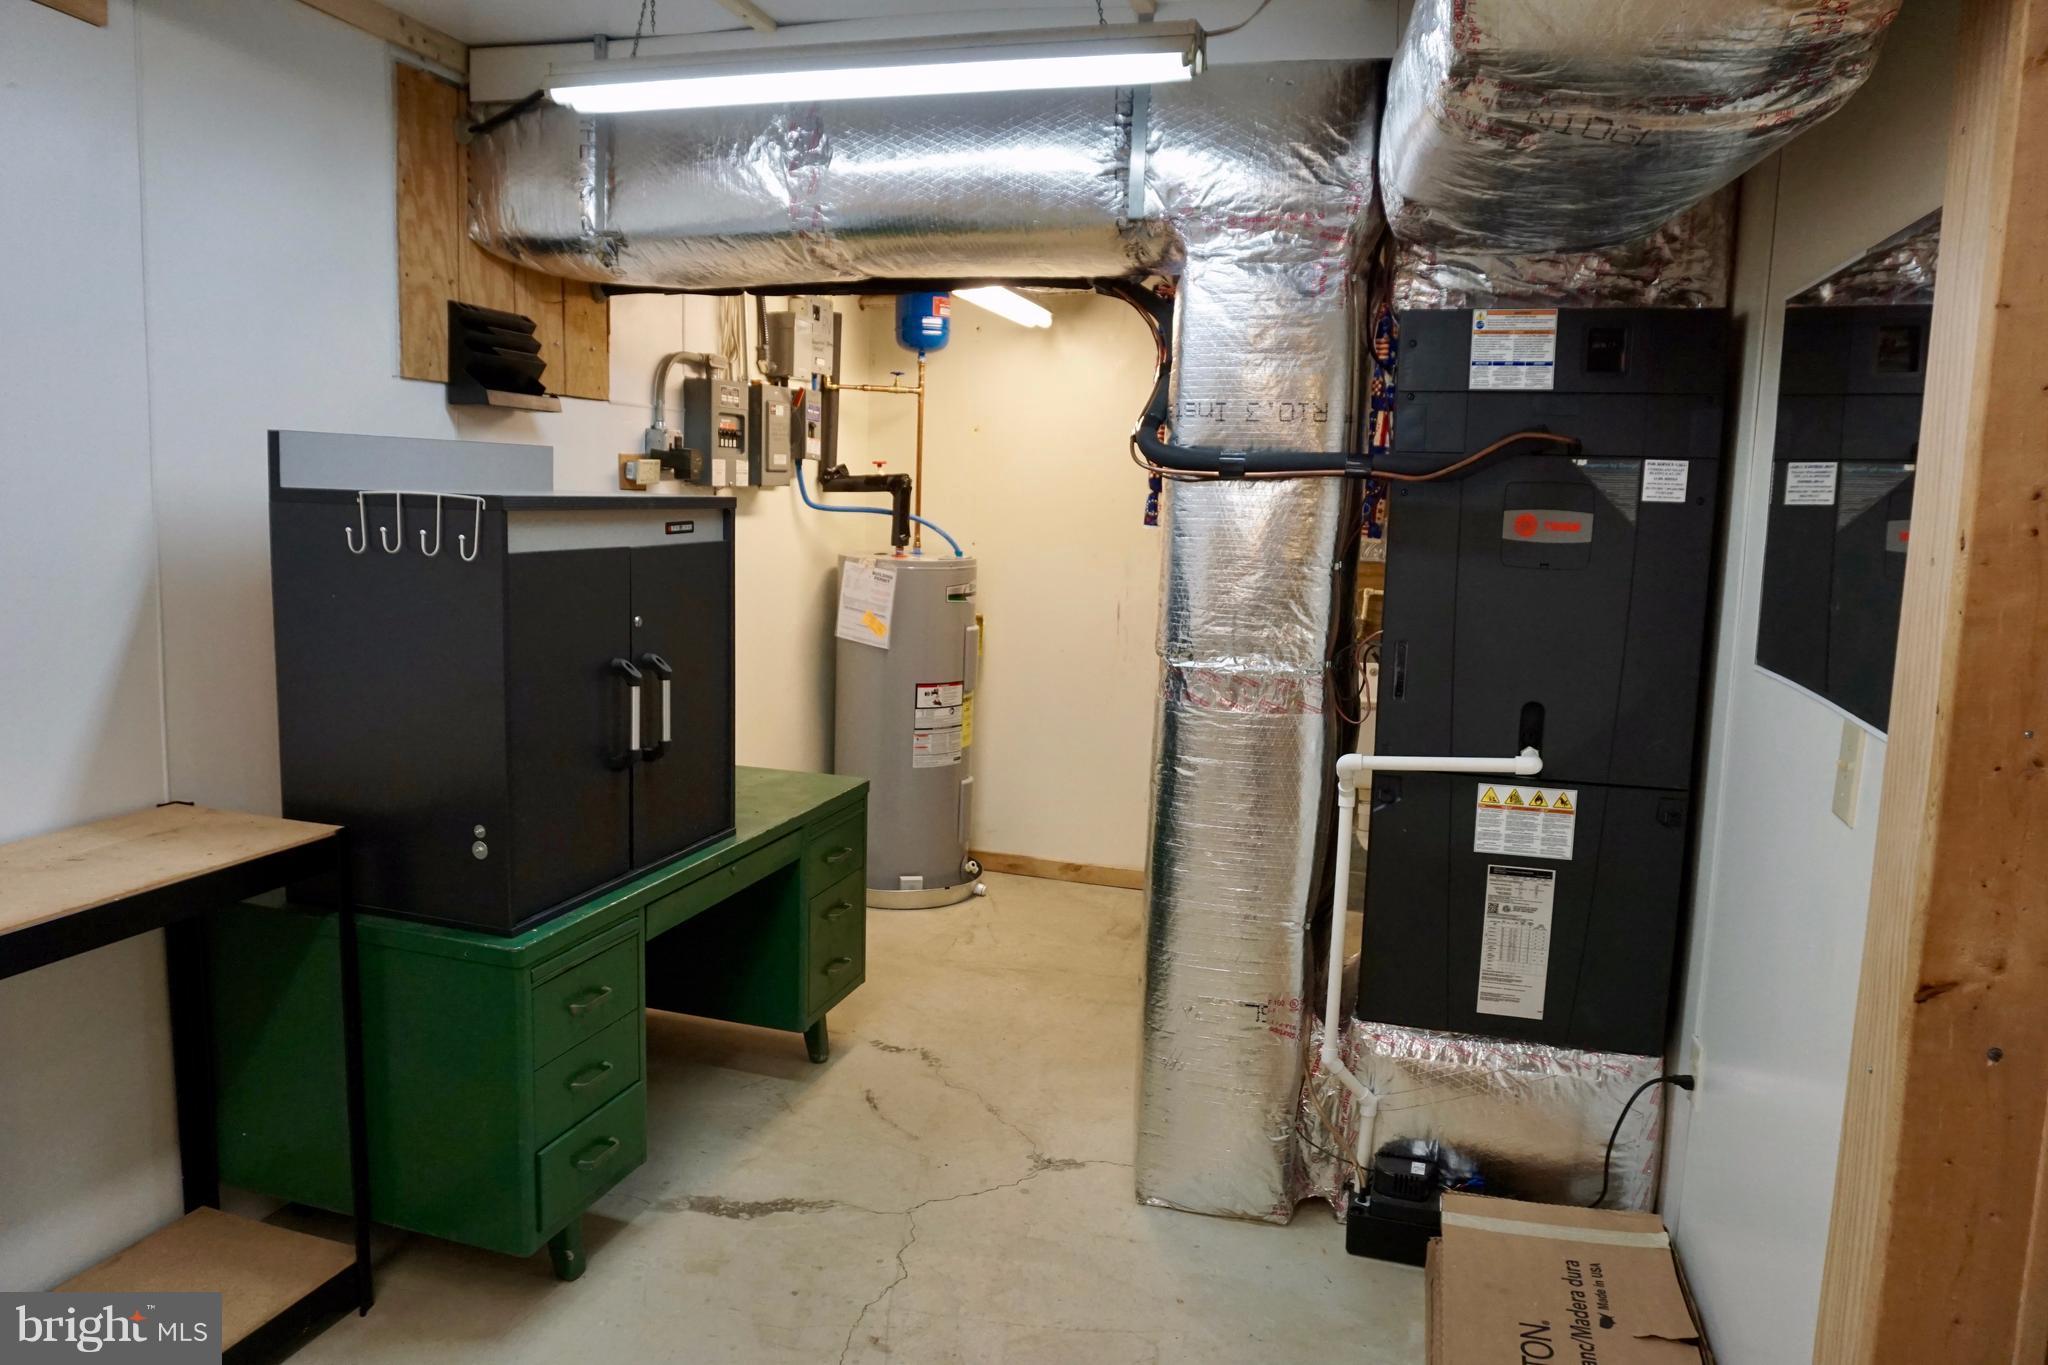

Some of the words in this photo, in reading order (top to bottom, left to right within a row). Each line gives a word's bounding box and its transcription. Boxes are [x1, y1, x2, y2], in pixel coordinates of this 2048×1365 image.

[1560, 1259, 1584, 1288] dura
[1588, 1262, 1603, 1279] USA
[1594, 1288, 1610, 1311] Made
